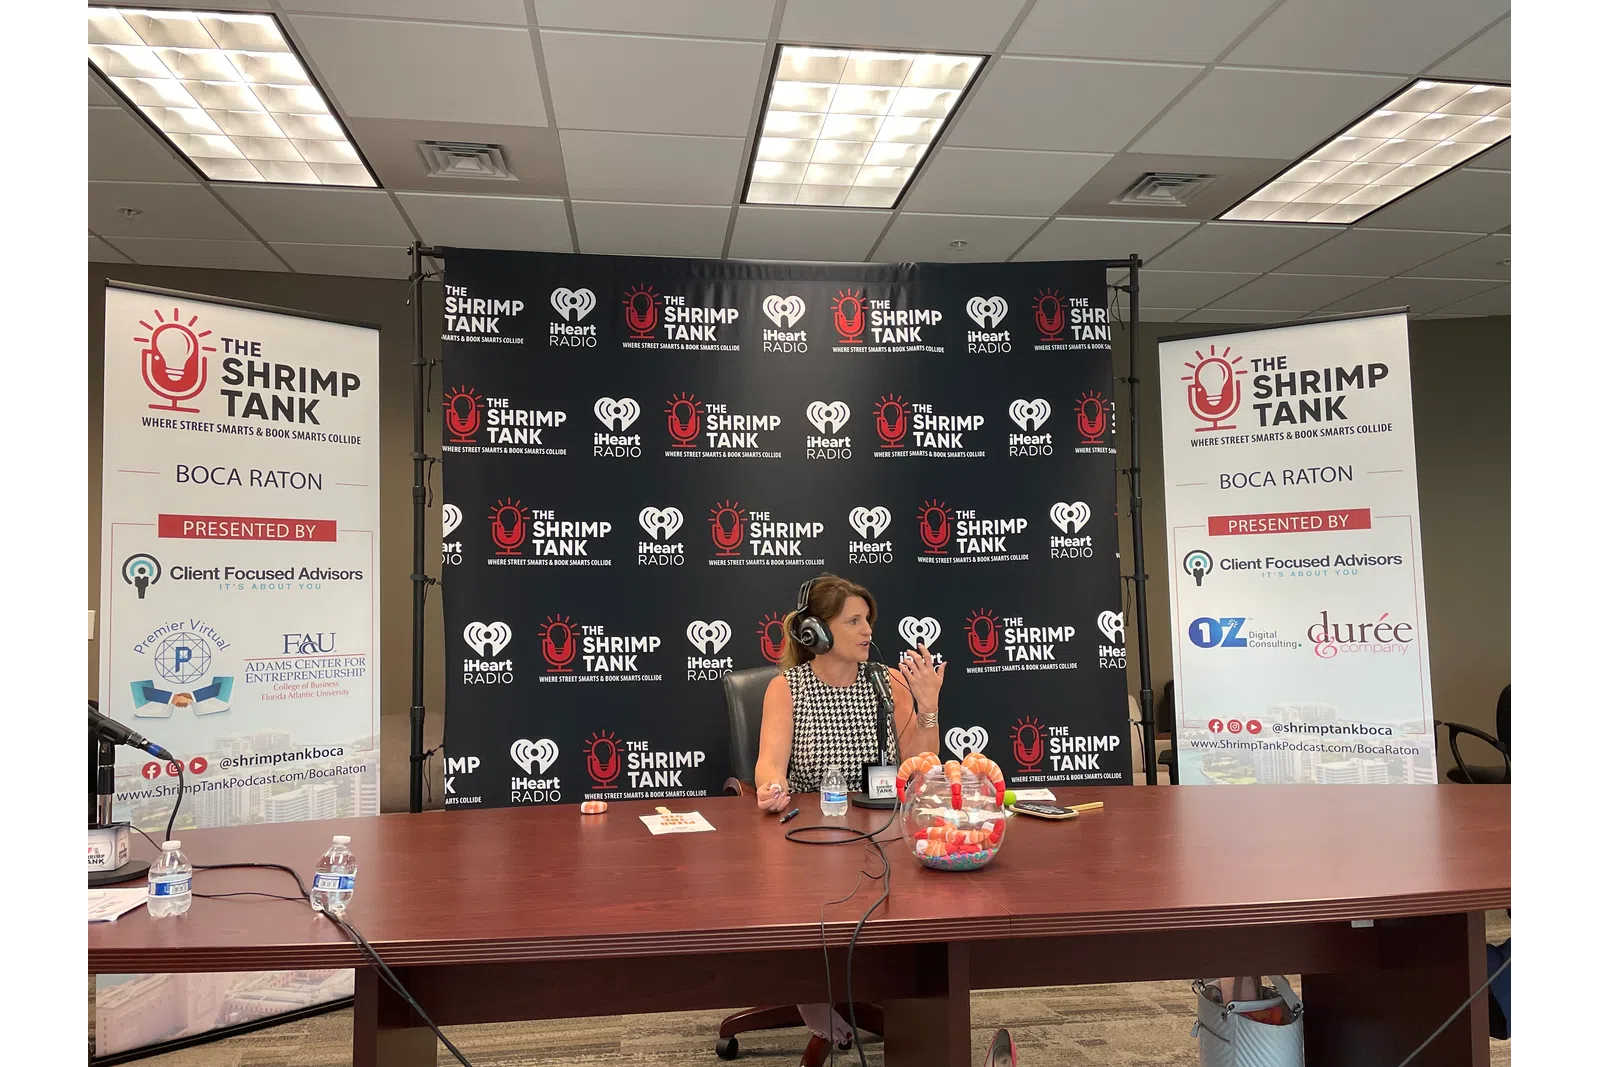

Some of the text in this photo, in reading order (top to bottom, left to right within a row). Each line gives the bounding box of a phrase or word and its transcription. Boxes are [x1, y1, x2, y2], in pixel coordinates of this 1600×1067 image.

[445, 285, 467, 297] THE
[445, 297, 524, 316] SHRIMP
[664, 296, 684, 305] THE
[870, 300, 890, 309] THE
[1069, 298, 1088, 307] THE
[664, 308, 739, 324] SHRIMP
[870, 309, 942, 325] SHRIMP
[445, 315, 499, 333] TANK
[550, 322, 596, 336] iHeart
[664, 325, 717, 341] TANK
[763, 330, 806, 341] iHeart
[871, 327, 922, 343] TANK
[967, 330, 1010, 342] iHeart
[1071, 325, 1111, 340] TAN
[221, 338, 261, 357] THE
[550, 336, 597, 347] RADIO
[764, 342, 807, 353] RADIO
[968, 342, 1011, 354] RADIO
[1251, 356, 1287, 372] THE
[222, 358, 360, 398] SHRIMP
[1253, 362, 1389, 399] SHRIMP
[220, 389, 320, 425] TANK
[487, 398, 508, 408] THE
[706, 404, 727, 413] THE
[912, 404, 932, 413] THE
[1253, 395, 1347, 426] TANK
[487, 410, 567, 427] SHRIMP
[706, 415, 781, 431] SHRIMP
[913, 415, 984, 431] SHRIMP
[142, 417, 361, 444] WHERE STREET SMARTS & BOOK SMARTS COLLIDE
[487, 428, 542, 444] TANK
[1191, 424, 1392, 447] WHERE STREET SMARTS & BOOK SMARTS COLLIDE
[594, 432, 640, 445] iHeart
[706, 433, 758, 448] TANK
[807, 436, 851, 447] iHeart
[913, 433, 963, 448] TANK
[1009, 433, 1052, 445] iHeart
[594, 446, 641, 458] RADIO
[807, 448, 851, 459] RADIO
[1009, 445, 1052, 456] RADIO
[176, 465, 322, 490] BOCA RATON
[1220, 466, 1352, 489] BOCA RATON
[532, 510, 554, 520] THE
[750, 512, 770, 520] THE
[956, 510, 976, 520] THE
[183, 521, 316, 538] PRESENTED BY
[532, 521, 611, 538] SHRIMP
[751, 522, 824, 538] SHRIMP
[956, 518, 1027, 536] SHRIMP
[1228, 515, 1349, 532] PRESENTED BY
[532, 539, 587, 556] TANK
[638, 542, 683, 554] iHeart
[751, 540, 802, 555] TANK
[850, 540, 892, 552] iHeart
[956, 537, 1006, 553] TANK
[1051, 535, 1092, 547] iHeart
[638, 554, 684, 566] RADIO
[850, 552, 893, 564] RADIO
[1051, 547, 1092, 559] RADIO
[1220, 554, 1402, 570] Client Focused Advisors
[170, 566, 363, 580] Client Focused Advisors
[1004, 617, 1023, 627] THE
[1307, 611, 1413, 644] durée
[133, 618, 231, 655] Premier Virtual
[582, 626, 604, 635] THE
[1004, 626, 1075, 643] SHRIMP
[1249, 631, 1277, 640] Digital
[282, 633, 336, 654] FAU
[583, 636, 661, 653] SHRIMP
[1314, 633, 1408, 658] & company
[1005, 645, 1055, 661] TANK
[245, 657, 365, 672] ADAMS CENTER FOR
[464, 659, 512, 672] iHeart
[583, 655, 638, 671] TANK
[688, 657, 733, 668] iHeart
[245, 668, 365, 683] ENTREPRENEURSHIP
[464, 672, 513, 684] RADIO
[274, 683, 300, 691] College
[1049, 727, 1069, 736] THE
[1272, 722, 1392, 737] @shrimptankboca
[627, 741, 648, 750] THE
[1049, 736, 1120, 753] SHRIMP
[1191, 739, 1419, 756] www.ShrimpTankPodcast.com/BocaRaton
[220, 747, 343, 770] @shrimptankboca
[627, 751, 705, 768] SHRIMP
[1050, 755, 1100, 771] TANK
[117, 764, 366, 801] www.ShrimpTankPodcast.com/BocaRaton
[511, 777, 560, 790] iHeart
[627, 771, 682, 788] TANK
[511, 790, 560, 802] RADIO
